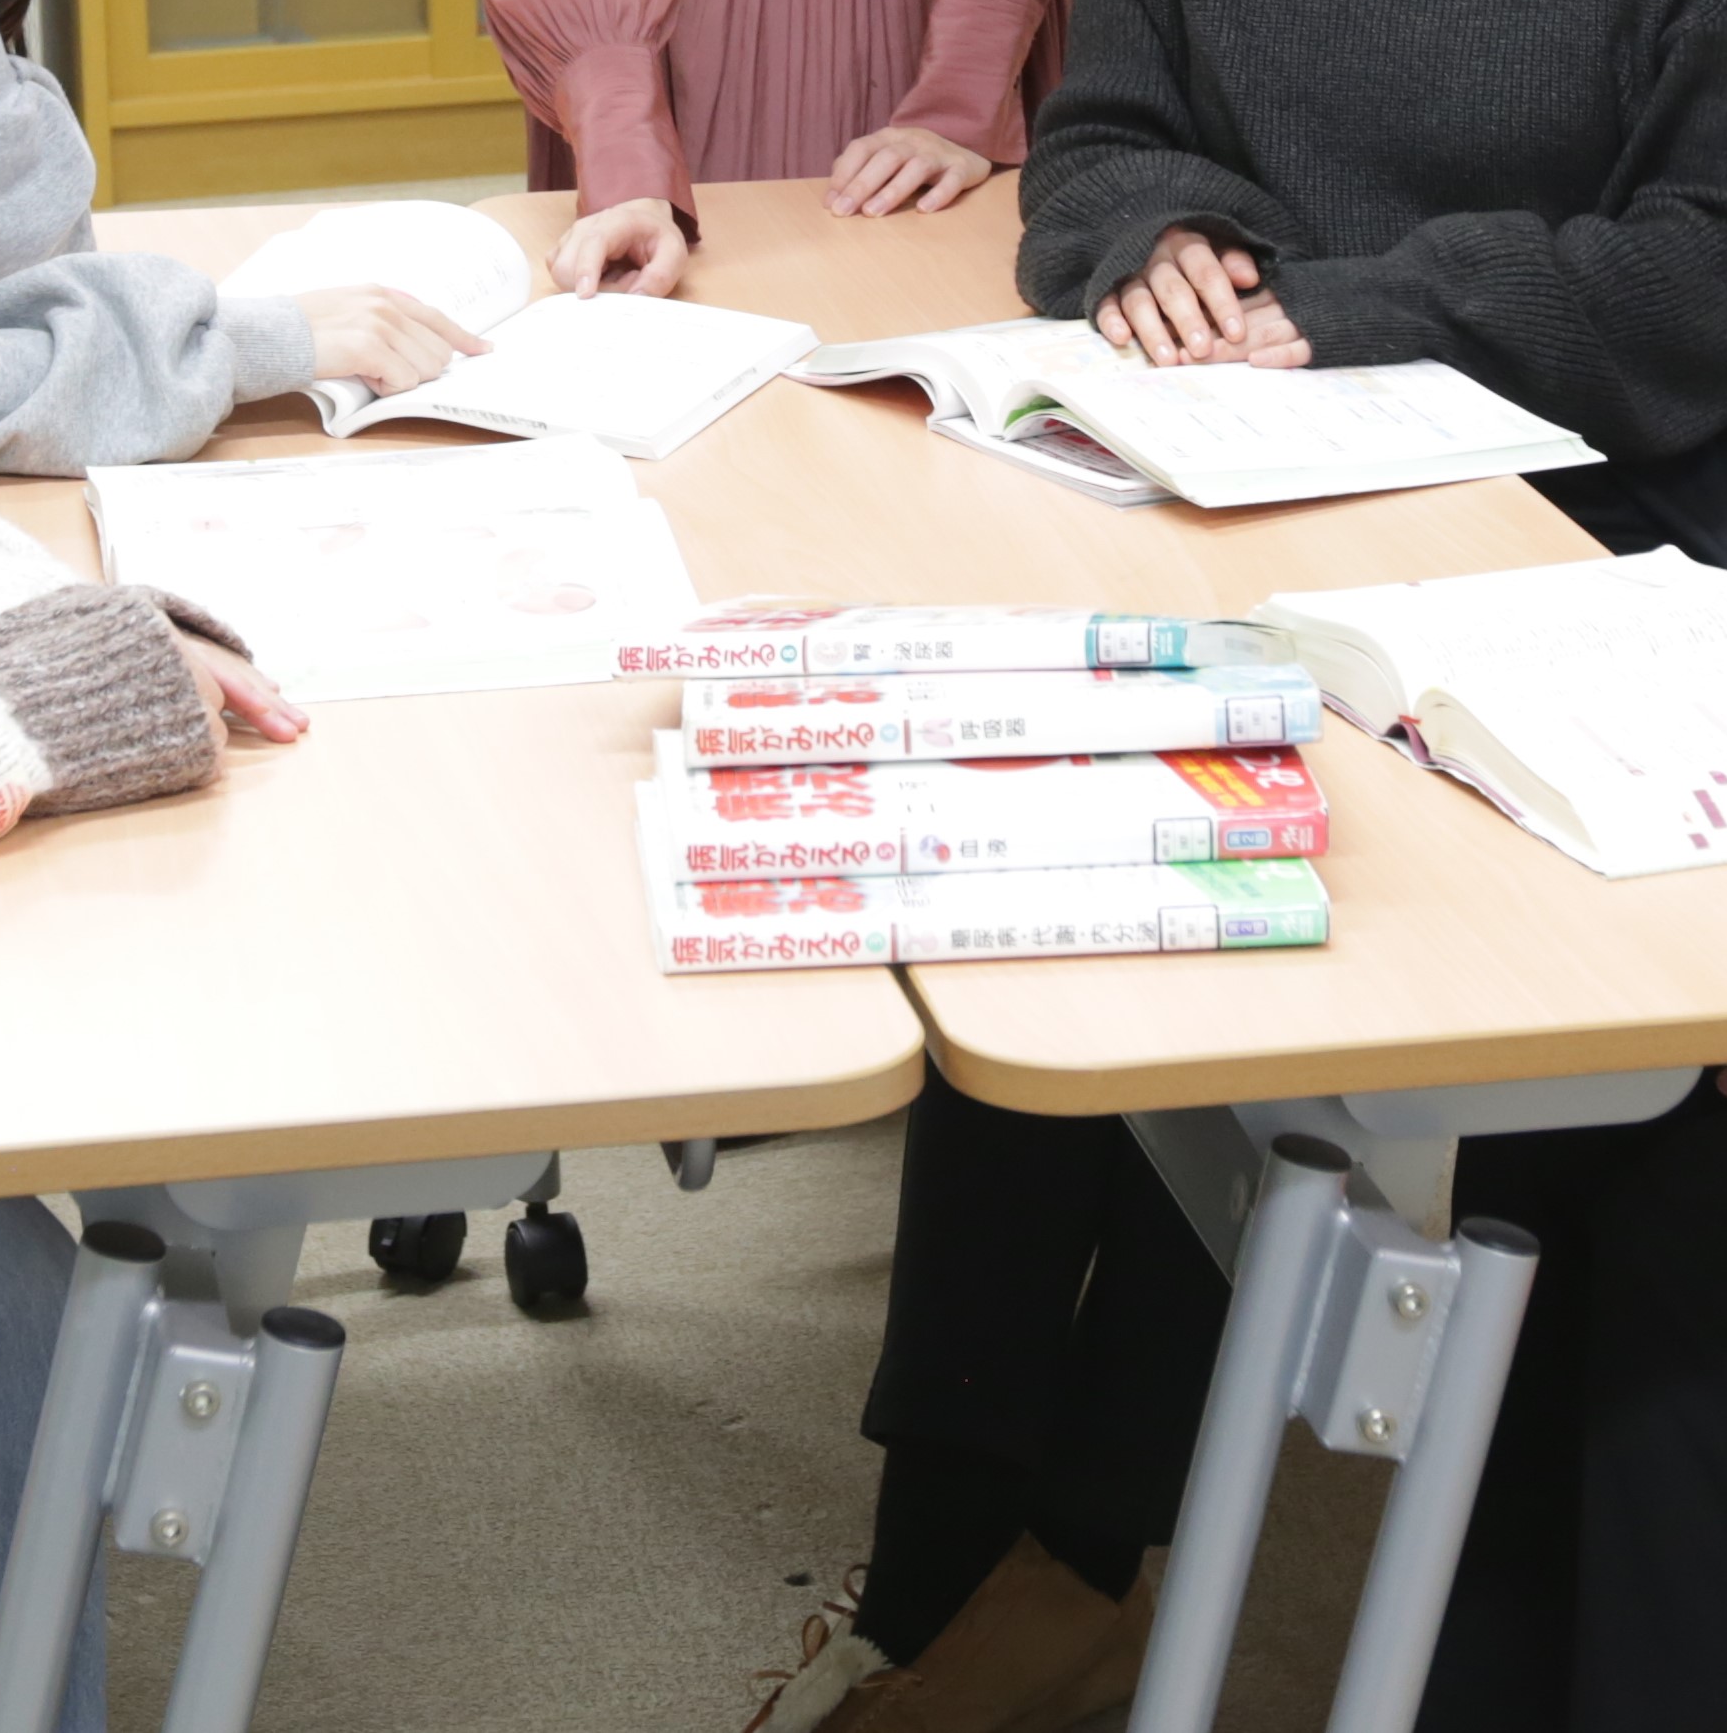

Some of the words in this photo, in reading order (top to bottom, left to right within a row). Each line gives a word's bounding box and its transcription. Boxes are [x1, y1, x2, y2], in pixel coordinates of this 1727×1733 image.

[617, 642, 776, 672] 病気がみえる
[696, 722, 875, 756] 病気がみえる
[961, 718, 1026, 740] 呼吸器
[686, 841, 870, 872] 病気がみえる
[959, 837, 1009, 859] 血液
[672, 930, 861, 964] 病気がみえる
[950, 922, 1157, 950] 糖尿病・代謝・内分泌
